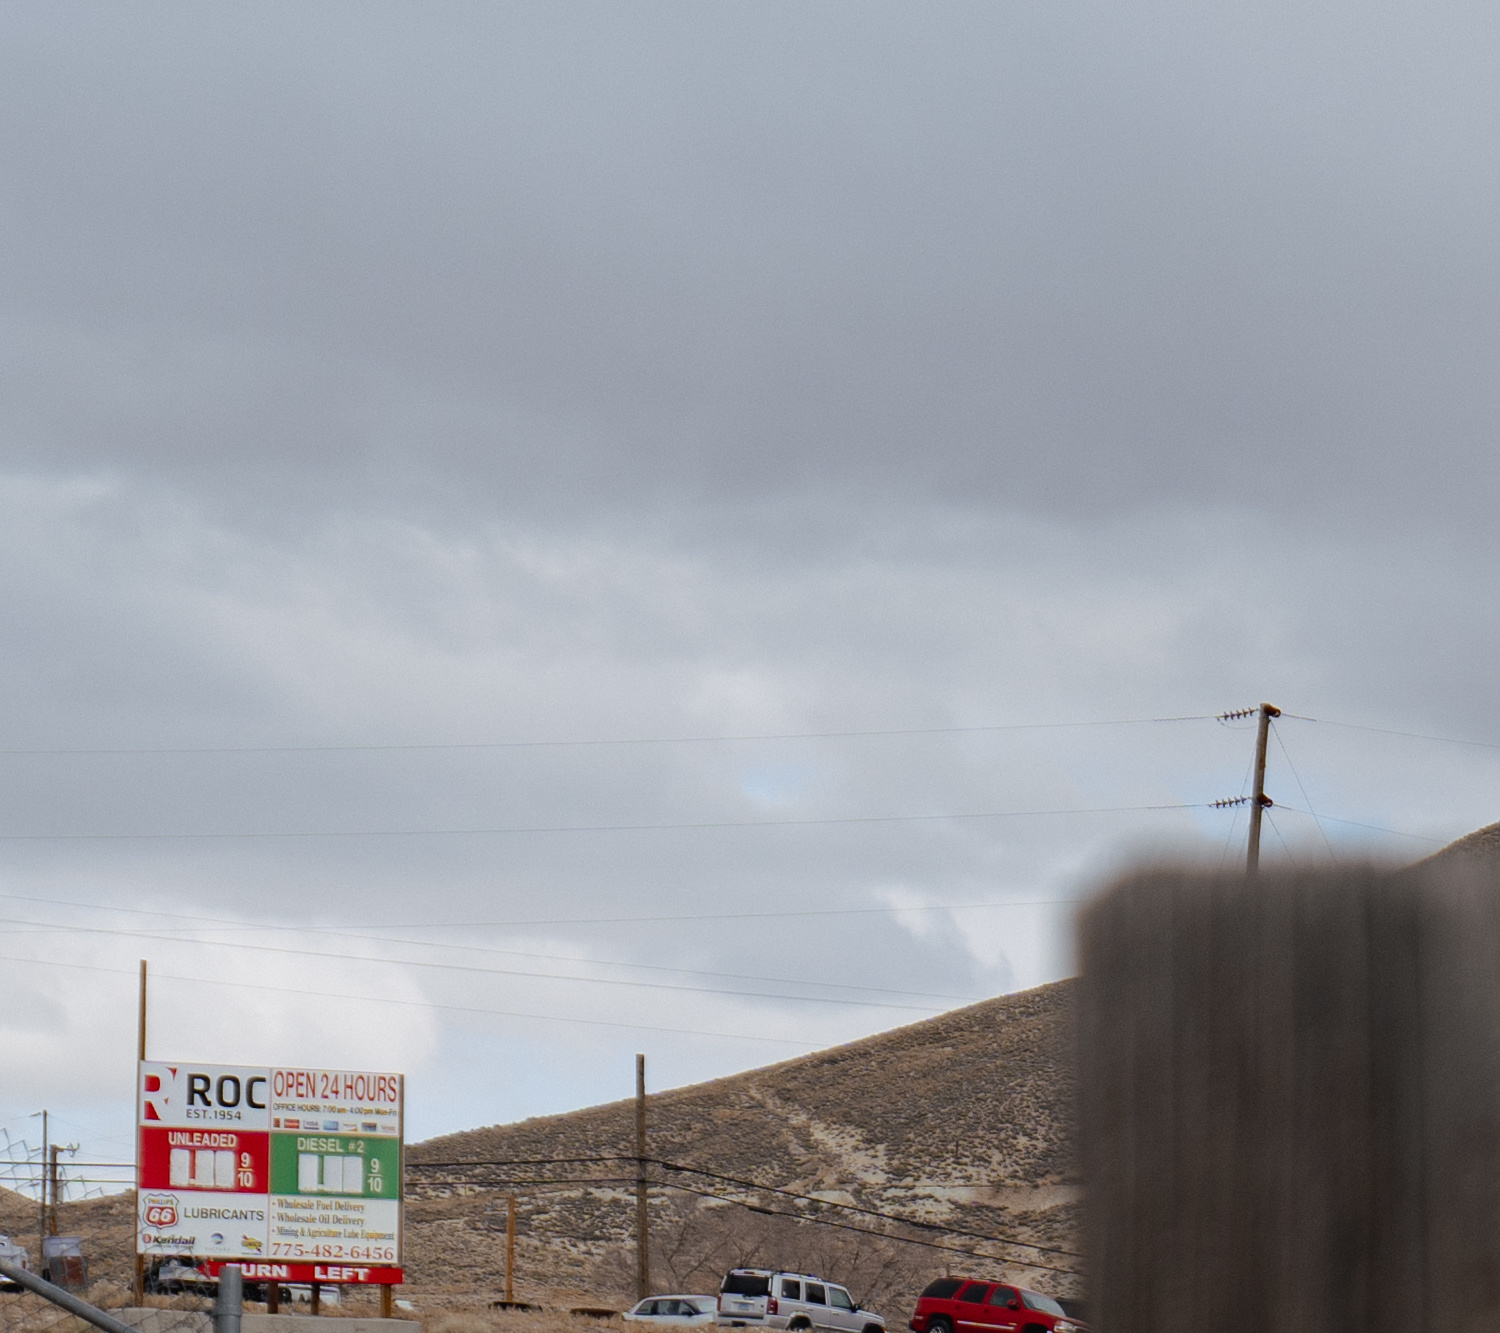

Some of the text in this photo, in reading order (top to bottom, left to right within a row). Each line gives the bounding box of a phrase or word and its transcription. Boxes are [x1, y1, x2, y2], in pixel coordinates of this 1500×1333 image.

[186, 1073, 267, 1110] ROC
[273, 1070, 398, 1103] OPEN 24 HOURS
[273, 1102, 296, 1112] OFFICE
[168, 1131, 237, 1148] UNLEADED
[297, 1137, 344, 1153] DIESEL
[240, 1152, 250, 1168] 9
[370, 1157, 380, 1174] 9
[238, 1171, 252, 1187] 10
[367, 1177, 382, 1193] 10
[184, 1206, 265, 1221] LUBRICANTS
[276, 1198, 365, 1214] Wholesale Fuel Delivery
[148, 1207, 173, 1223] 66
[276, 1212, 365, 1227] Wholesale Oil Delivery
[153, 1234, 196, 1246] Kendall
[276, 1226, 299, 1239] Mining
[307, 1227, 342, 1240] Agriculture
[343, 1229, 359, 1239] Lube
[360, 1230, 395, 1242] Equipment
[272, 1242, 395, 1261] 775-482-6456
[226, 1262, 369, 1281] URN LEFT
